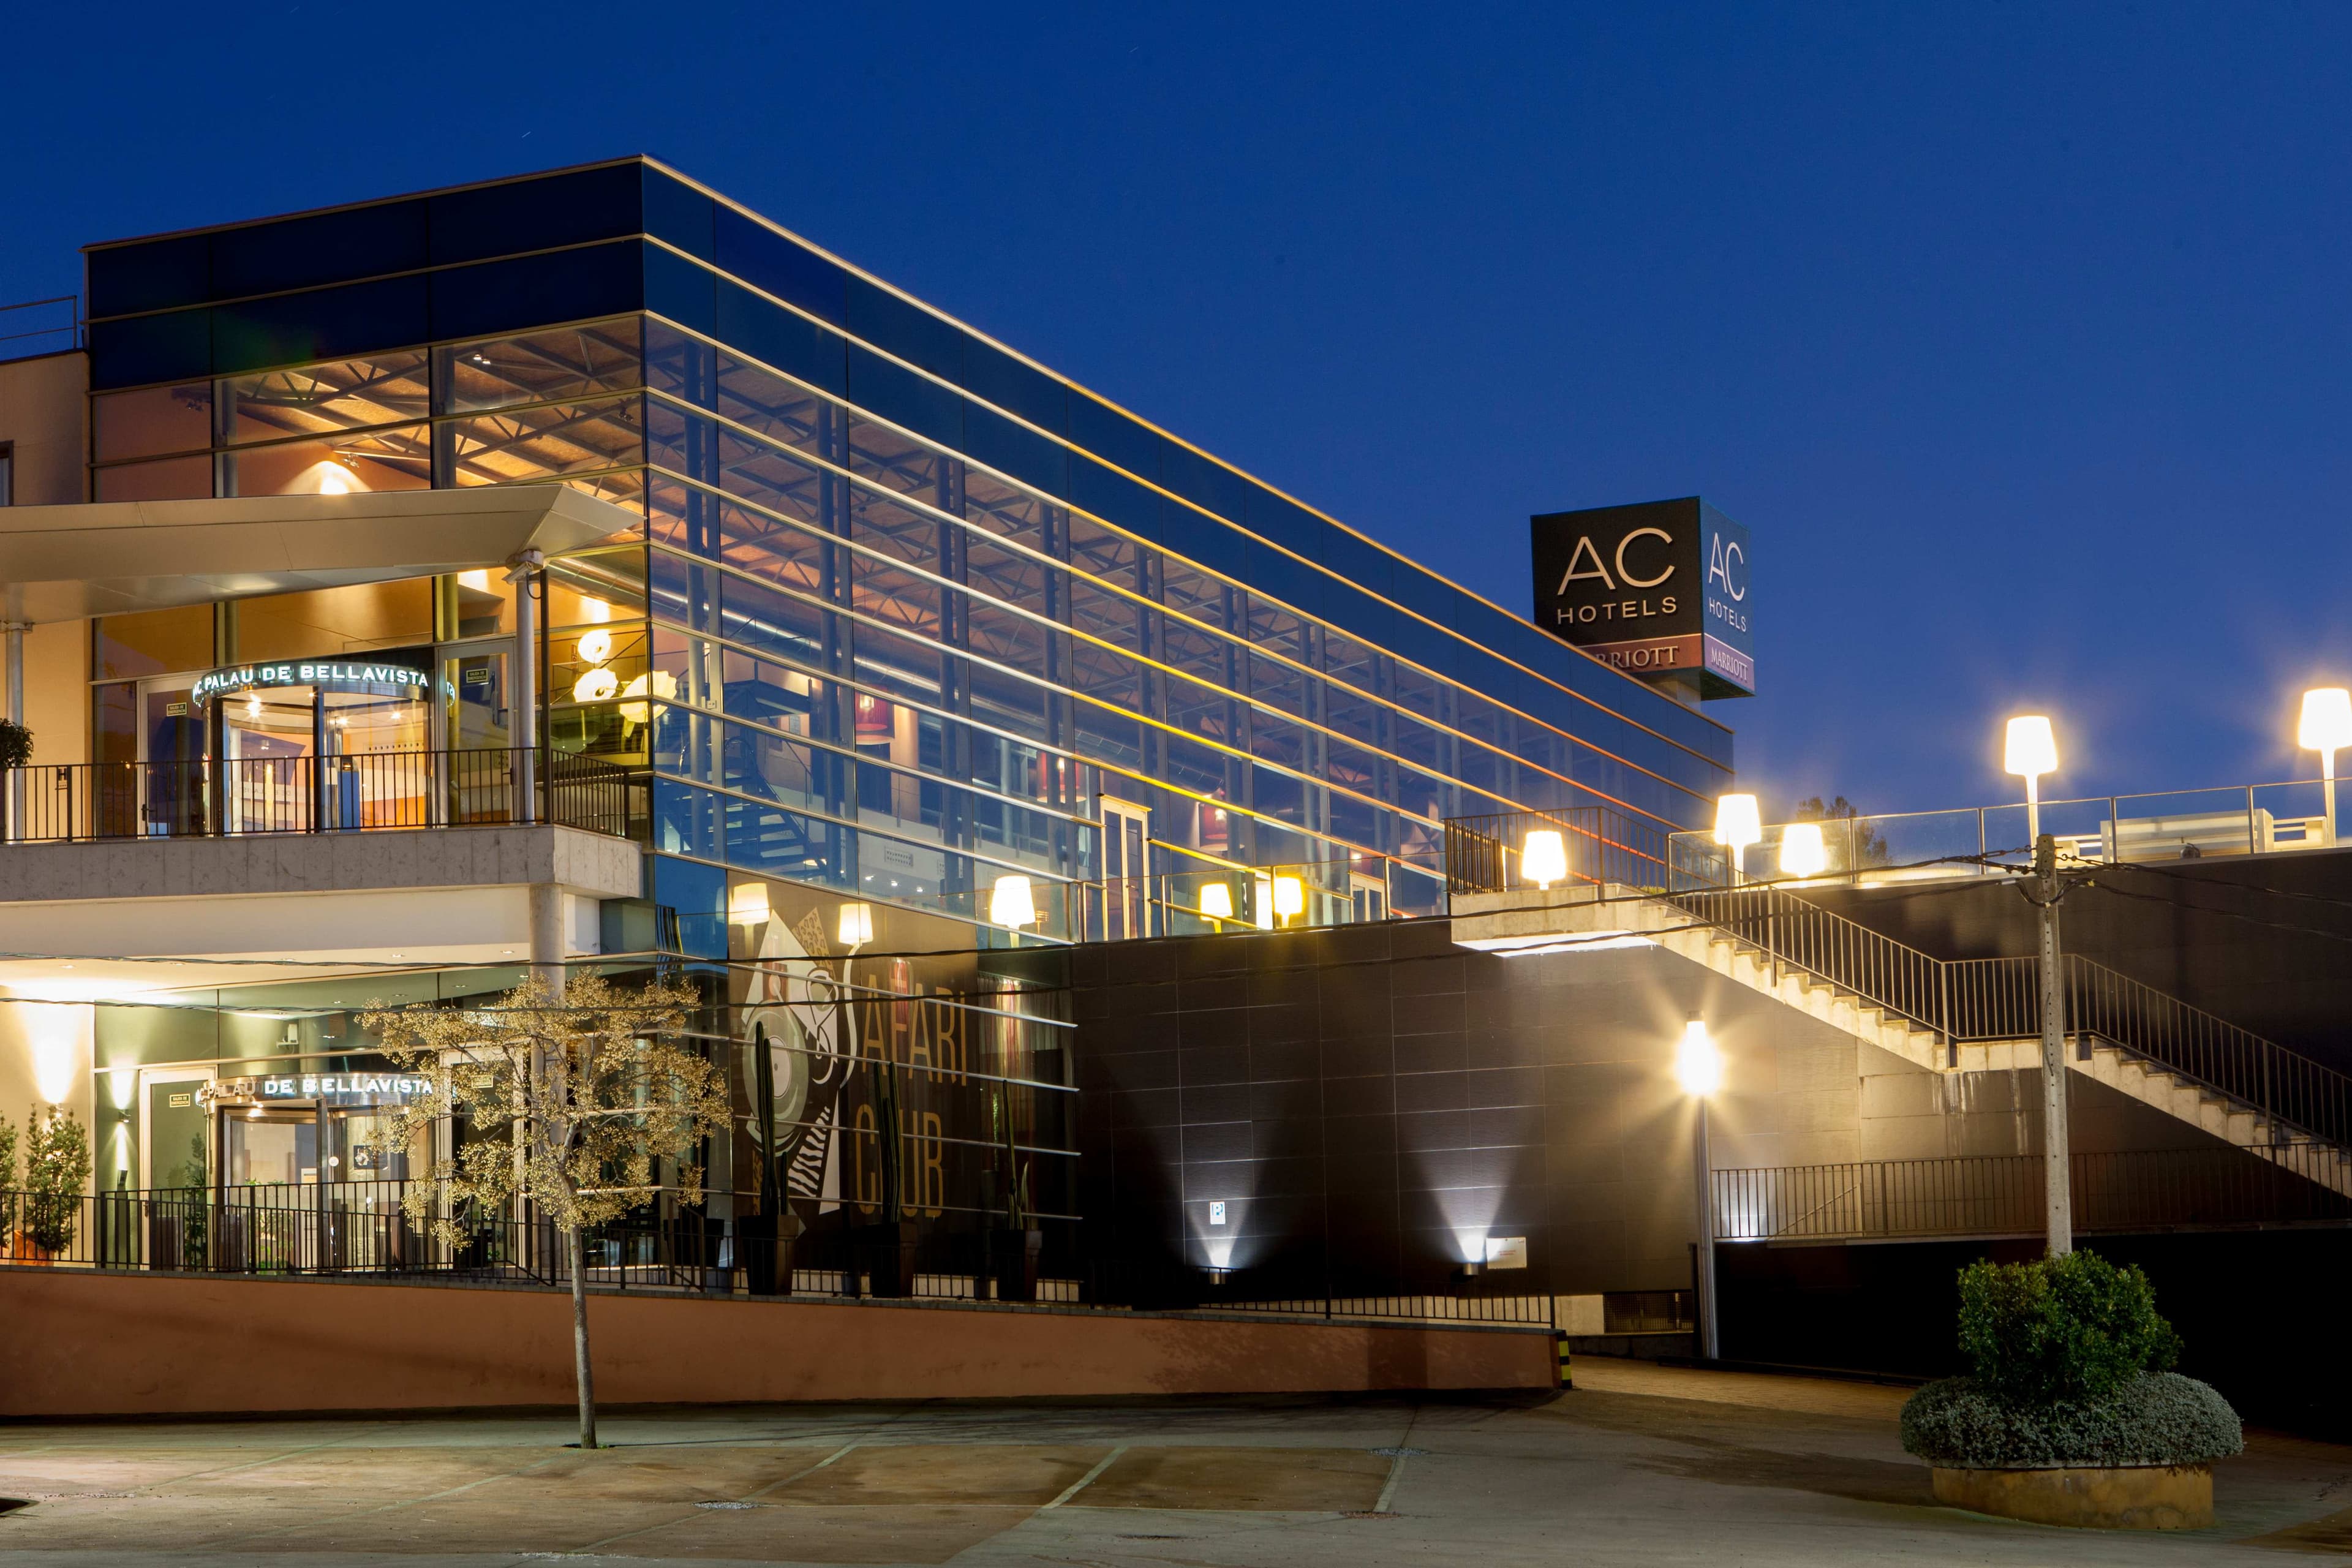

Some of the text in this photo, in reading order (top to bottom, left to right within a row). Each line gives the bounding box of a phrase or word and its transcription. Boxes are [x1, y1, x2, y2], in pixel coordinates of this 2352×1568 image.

[1557, 527, 1676, 595] AC
[1709, 532, 1745, 602] AC
[1557, 597, 1678, 625] HOTELS
[1709, 597, 1747, 633] HOTELS
[205, 669, 254, 690] PALAU
[263, 666, 291, 681] DE
[300, 665, 429, 687] BELLAVISTA
[1711, 646, 1748, 681] MARRIOTT
[208, 1080, 256, 1099] PALAU
[265, 1079, 293, 1095] DE
[303, 1078, 432, 1095] BELLAVISTA
[855, 1103, 944, 1218] CUB
